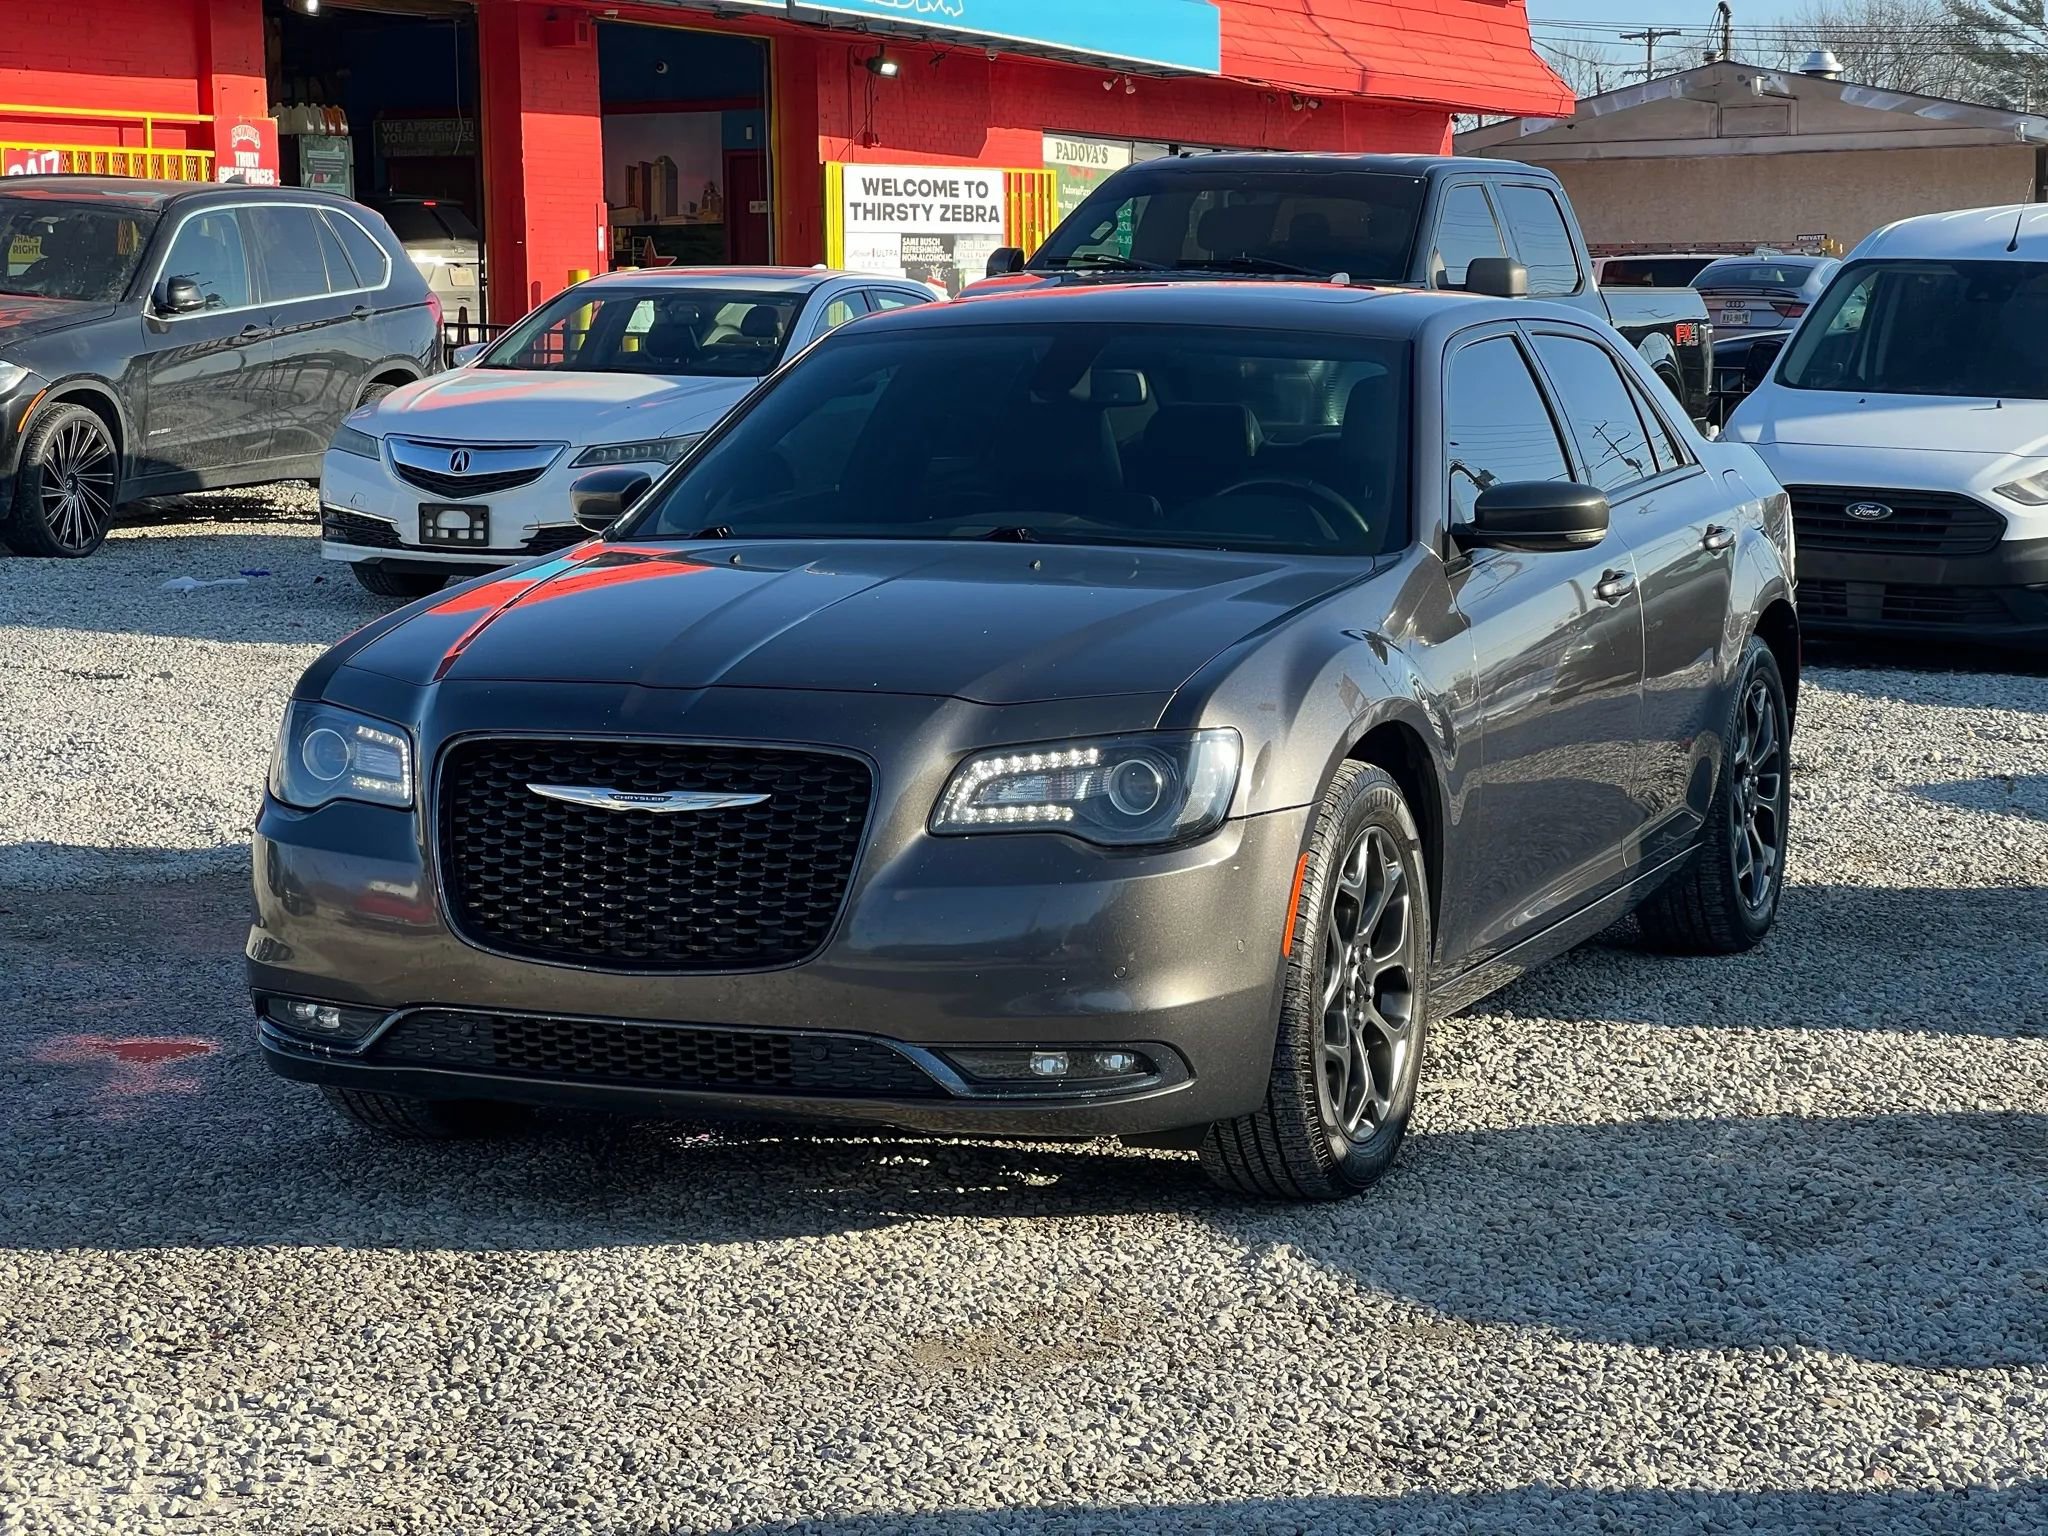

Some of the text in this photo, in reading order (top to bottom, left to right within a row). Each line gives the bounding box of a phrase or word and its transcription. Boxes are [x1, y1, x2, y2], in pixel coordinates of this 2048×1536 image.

[382, 122, 402, 133] WE
[382, 133, 415, 144] YOUR
[234, 151, 259, 167] TRULY
[1056, 142, 1108, 164] PADOVA'S
[245, 168, 275, 186] PRICES
[862, 177, 989, 198] WELCOME TO
[849, 202, 1000, 223] THIRSTY ZEBRA
[13, 233, 40, 244] THAT'S
[902, 238, 941, 246] SAME BUSCH
[12, 245, 40, 255] RIGHT
[902, 245, 945, 254] REFRESHMENT.
[902, 253, 953, 262] NON-ALCOHOLIC.
[1676, 323, 1698, 345] FX4
[1854, 504, 1881, 517] Ford
